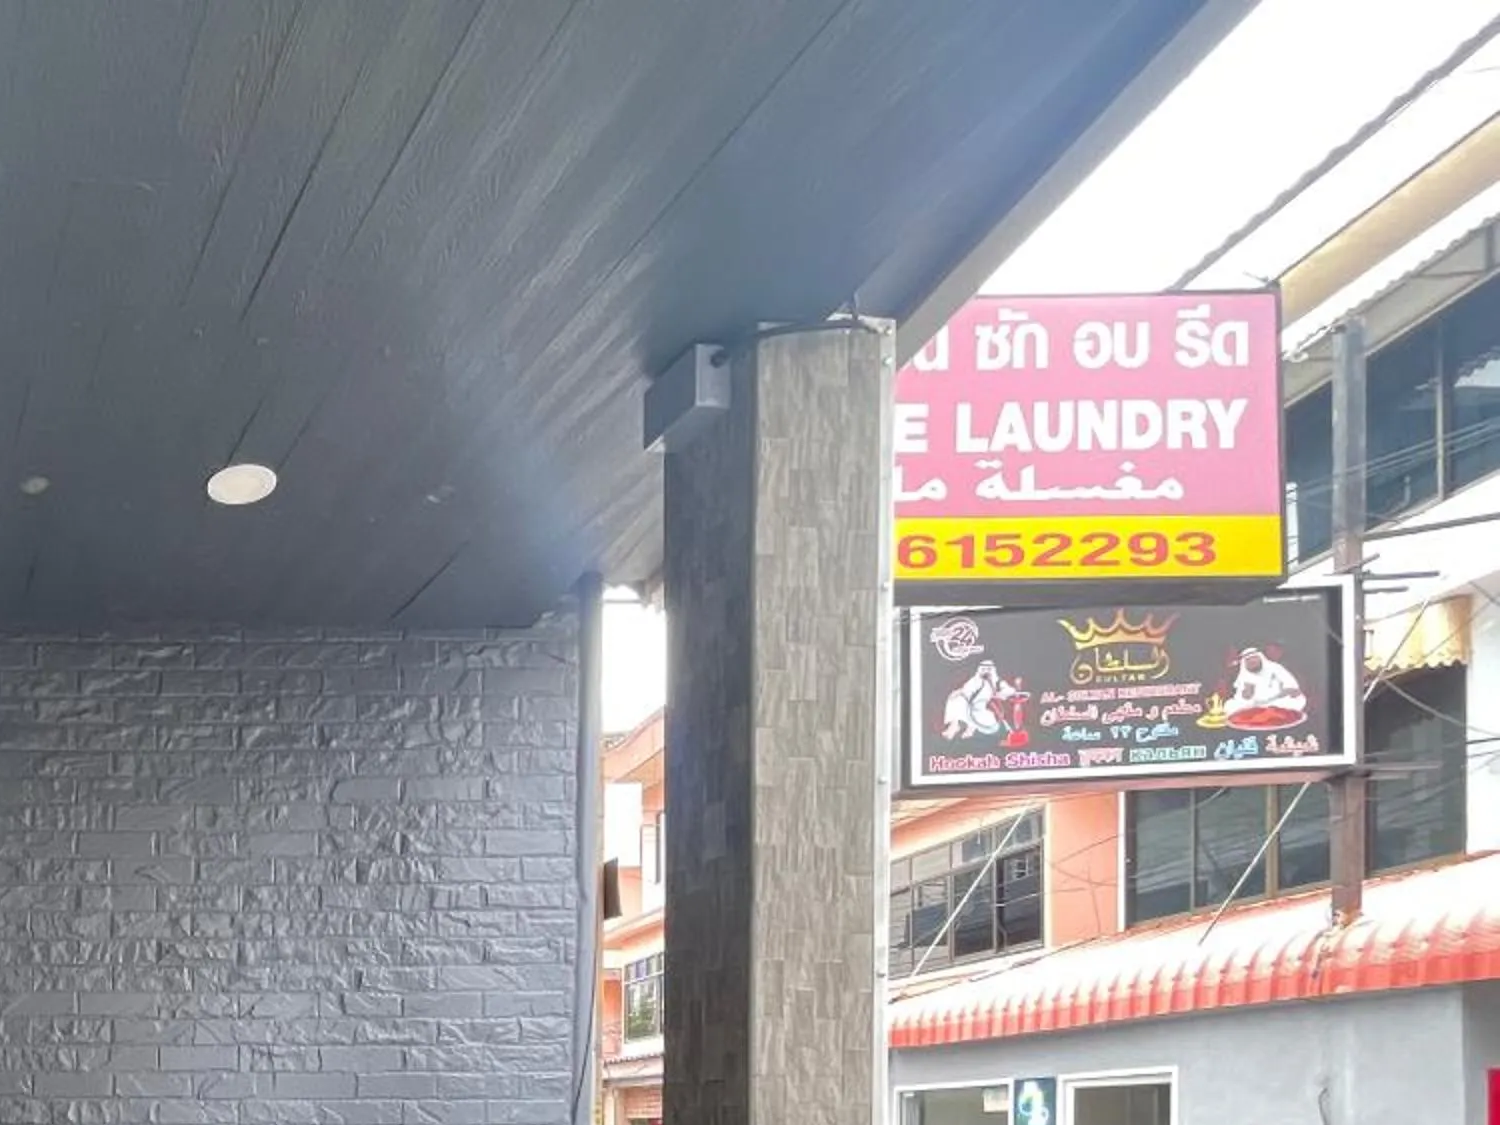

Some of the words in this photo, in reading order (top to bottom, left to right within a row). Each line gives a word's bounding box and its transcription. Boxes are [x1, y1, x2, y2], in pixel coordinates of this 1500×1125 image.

[975, 307, 1049, 371] ซัก
[1073, 321, 1150, 369] อบ
[1174, 304, 1249, 368] รีด
[894, 402, 929, 453] E
[956, 398, 1248, 453] LAUNDRY
[973, 458, 1186, 501] مغسلة
[897, 531, 1218, 569] 6152293
